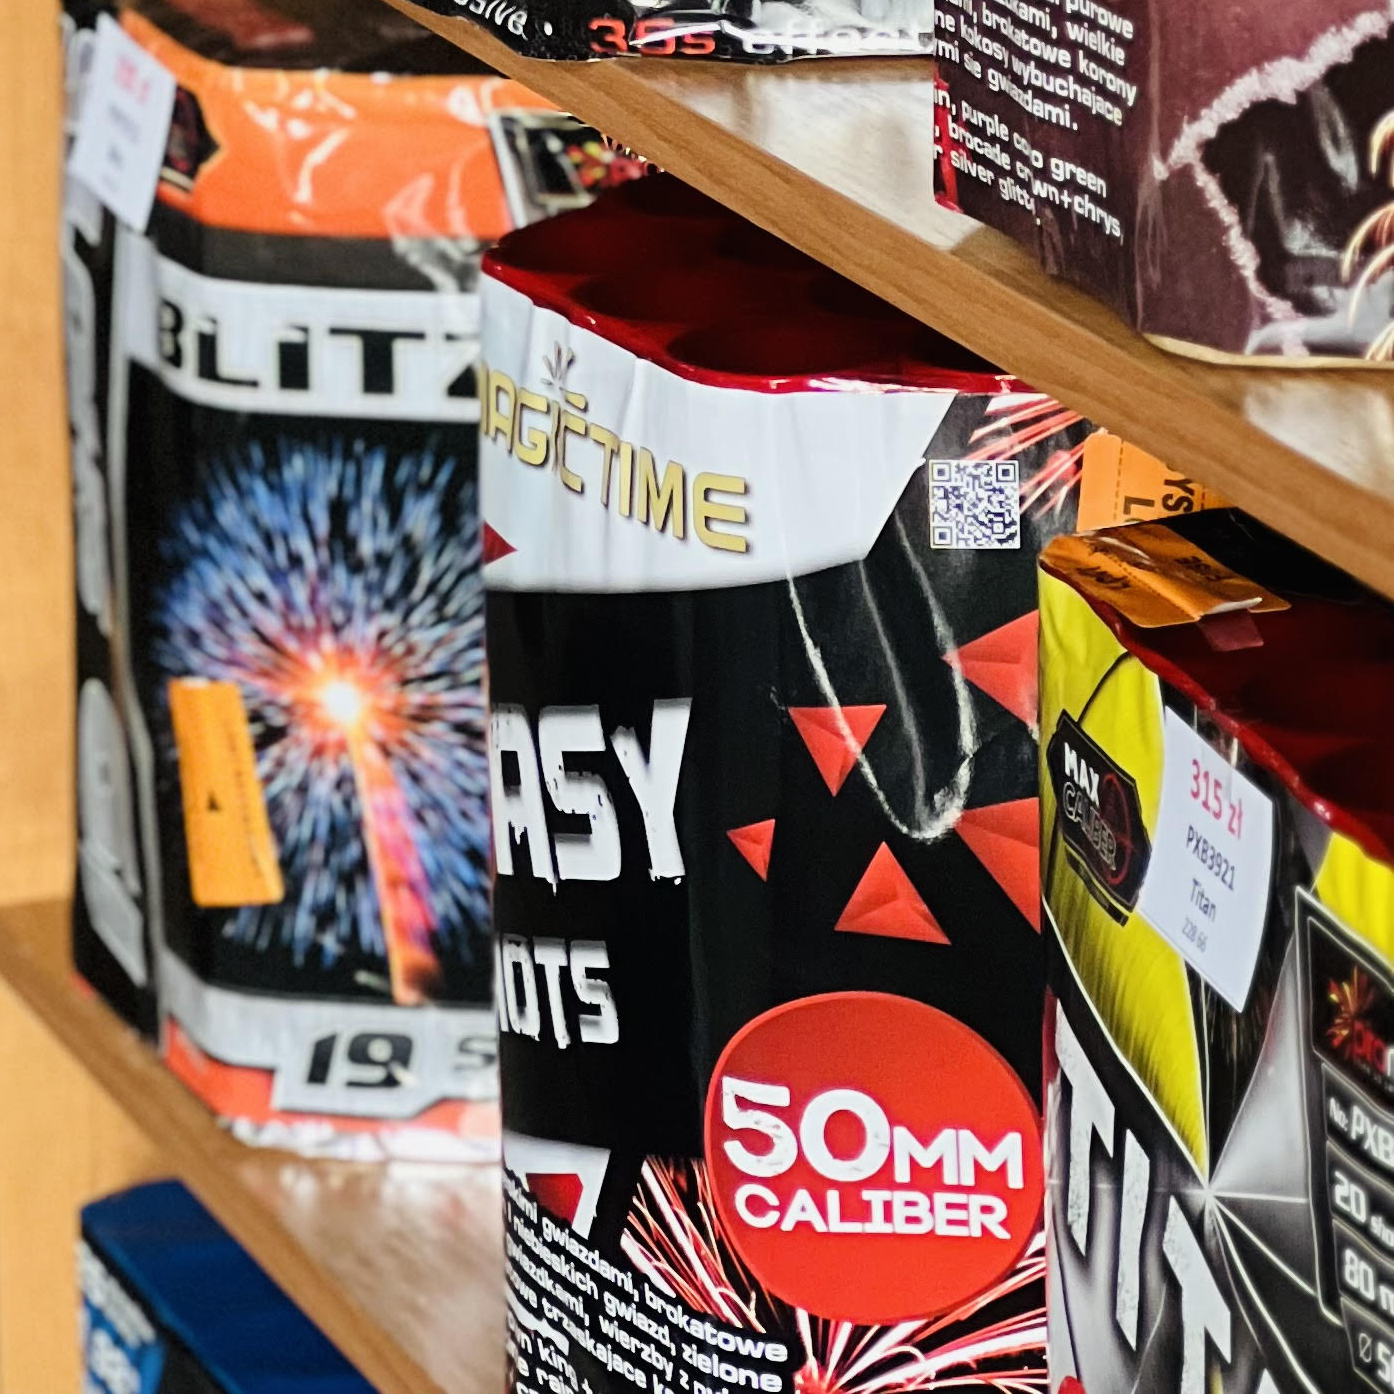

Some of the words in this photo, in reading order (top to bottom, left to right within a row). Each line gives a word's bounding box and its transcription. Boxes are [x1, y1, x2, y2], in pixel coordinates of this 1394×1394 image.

[1065, 20, 1125, 67] wielkie
[1011, 54, 1123, 126] wybuchajace
[1077, 49, 1137, 107] korony
[947, 113, 1012, 171] brocade
[1016, 161, 1125, 247] crwn+chrys,
[950, 148, 995, 186] silver
[961, 99, 1010, 142] purple
[1049, 157, 1108, 200] green
[1064, 741, 1100, 807] MAX
[1189, 758, 1224, 821] 315
[1185, 825, 1237, 892] PXB3921
[1190, 877, 1218, 923] Titan
[306, 1031, 414, 1089] 19
[719, 1075, 1025, 1191] 50MM
[733, 1182, 1012, 1242] CALIBER
[1055, 997, 1281, 1394] TIT
[1332, 1169, 1367, 1224] 20
[541, 1215, 639, 1303] gwiazdami,
[644, 1281, 789, 1363] brokatowe
[1343, 1247, 1376, 1302] 80
[541, 1297, 647, 1389] trzaskajace
[598, 1314, 674, 1382] wierzby
[678, 1368, 690, 1391] z
[603, 1290, 677, 1357] gwiazd,
[681, 1342, 783, 1393] zielone
